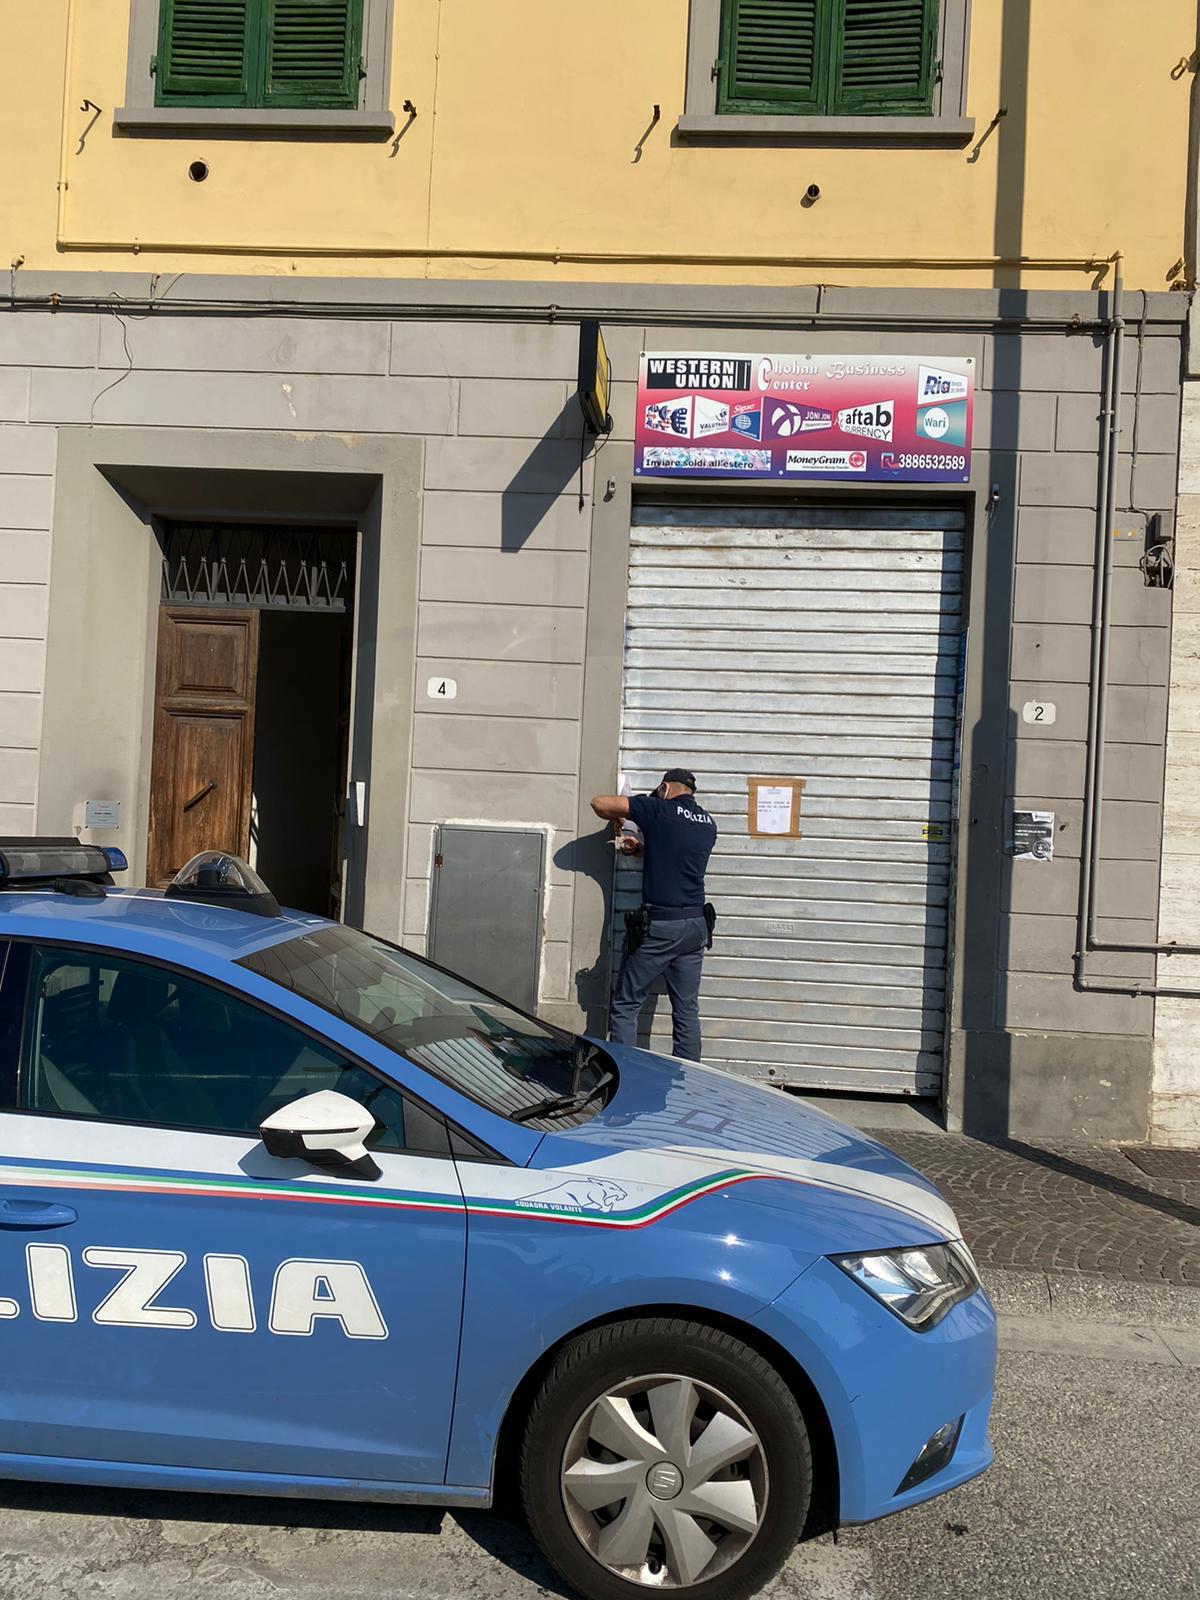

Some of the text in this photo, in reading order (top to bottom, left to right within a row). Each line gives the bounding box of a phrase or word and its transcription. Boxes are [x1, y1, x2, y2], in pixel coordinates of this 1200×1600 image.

[650, 360, 734, 375] WESTERN
[825, 361, 906, 379] Business
[676, 374, 734, 389] UNION
[924, 375, 951, 396] Ria
[805, 411, 820, 420] JONI
[845, 404, 892, 427] aftab
[924, 417, 946, 429] Wari
[845, 424, 891, 440] CURRENCY
[646, 458, 681, 467] Inviare
[683, 459, 706, 467] soldi
[788, 455, 845, 465] MoneyGram
[898, 453, 965, 470] 3886532589
[438, 681, 446, 695] 4
[1034, 706, 1044, 721] 2
[677, 805, 712, 825] POLIZIA
[515, 1200, 583, 1213] SQUADRA VOLANTE
